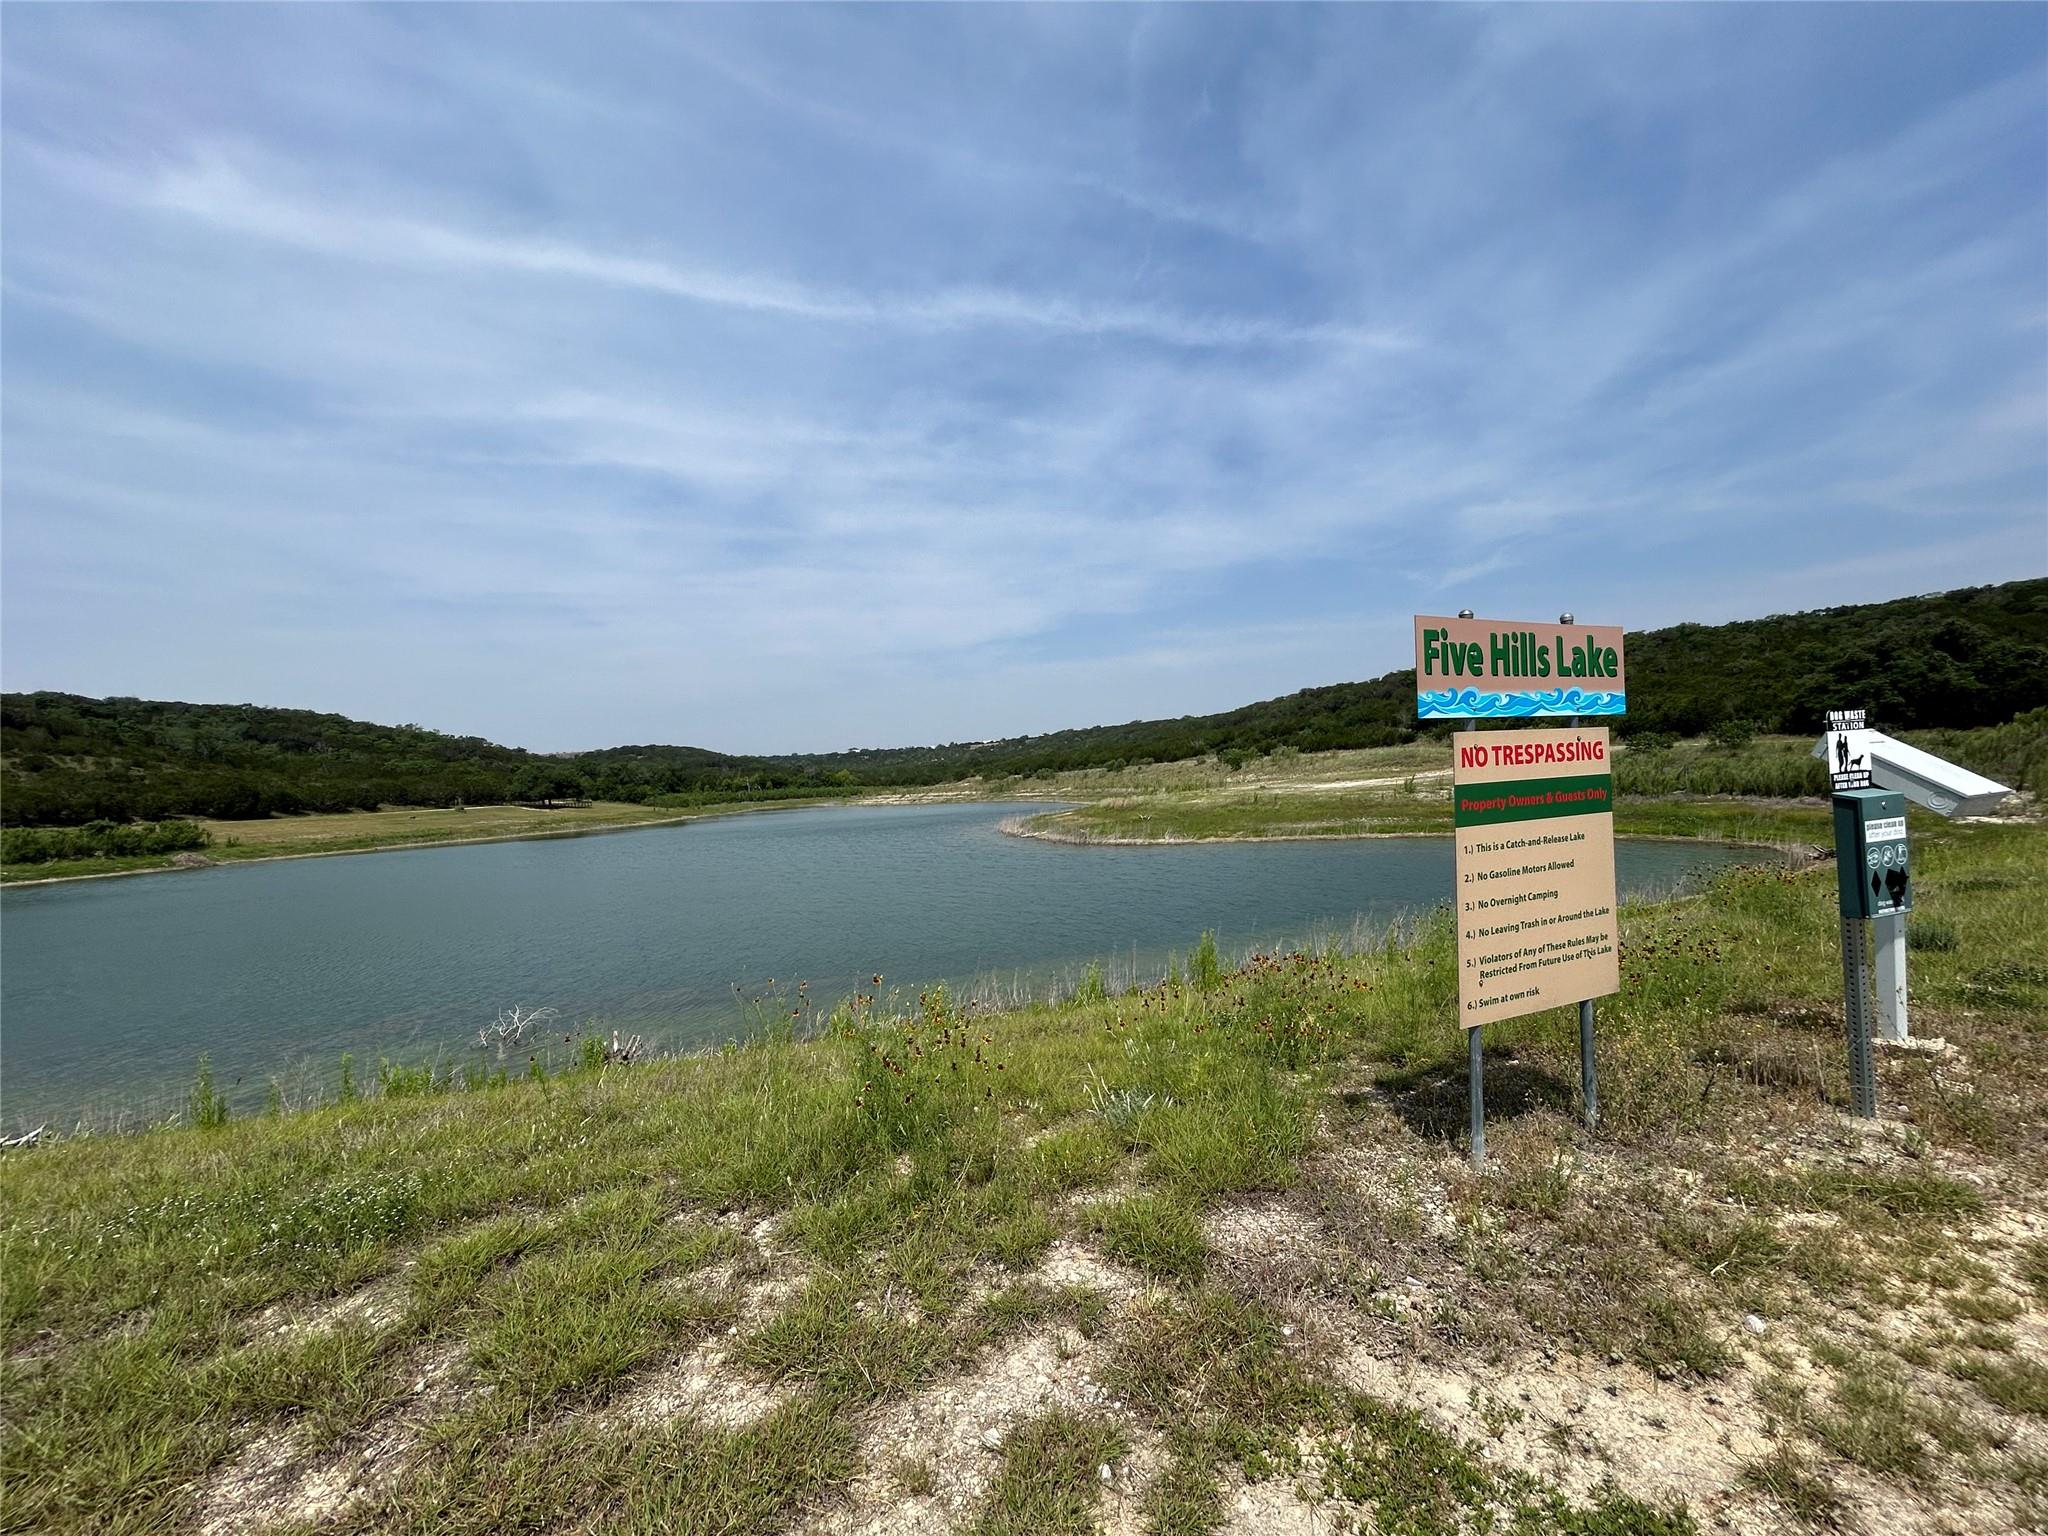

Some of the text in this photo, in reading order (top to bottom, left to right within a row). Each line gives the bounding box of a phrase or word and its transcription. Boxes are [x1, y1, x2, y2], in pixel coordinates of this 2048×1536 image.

[1423, 627, 1618, 677] Five Hills Lake
[1832, 722, 1864, 730] STATION
[1461, 740, 1604, 768] NO TRESPASSING
[1460, 787, 1607, 811] Property Owners & Guests Only
[1464, 845, 1474, 855] 1.)
[1476, 843, 1491, 853] This
[1493, 843, 1499, 851] is
[1506, 835, 1569, 849] Catch-and-Release
[1569, 832, 1585, 841] Lake
[1464, 859, 1574, 883] 2.) No Gasoline Motors Allowed
[1465, 889, 1558, 912] 3.) No Overnight Camping
[1466, 930, 1476, 940] 4.)
[1479, 928, 1490, 937] No
[1491, 923, 1520, 935] Leaving
[1520, 919, 1539, 929] Trash
[1558, 912, 1582, 924] Around
[1583, 909, 1594, 918] the
[1595, 906, 1610, 916] Lake
[1466, 933, 1608, 969] 5.) Violators of Any of These Rules May be
[1480, 944, 1612, 980] Restricted From Future Use of This Lake
[1467, 986, 1540, 1010] 6.) Swim at own risk
